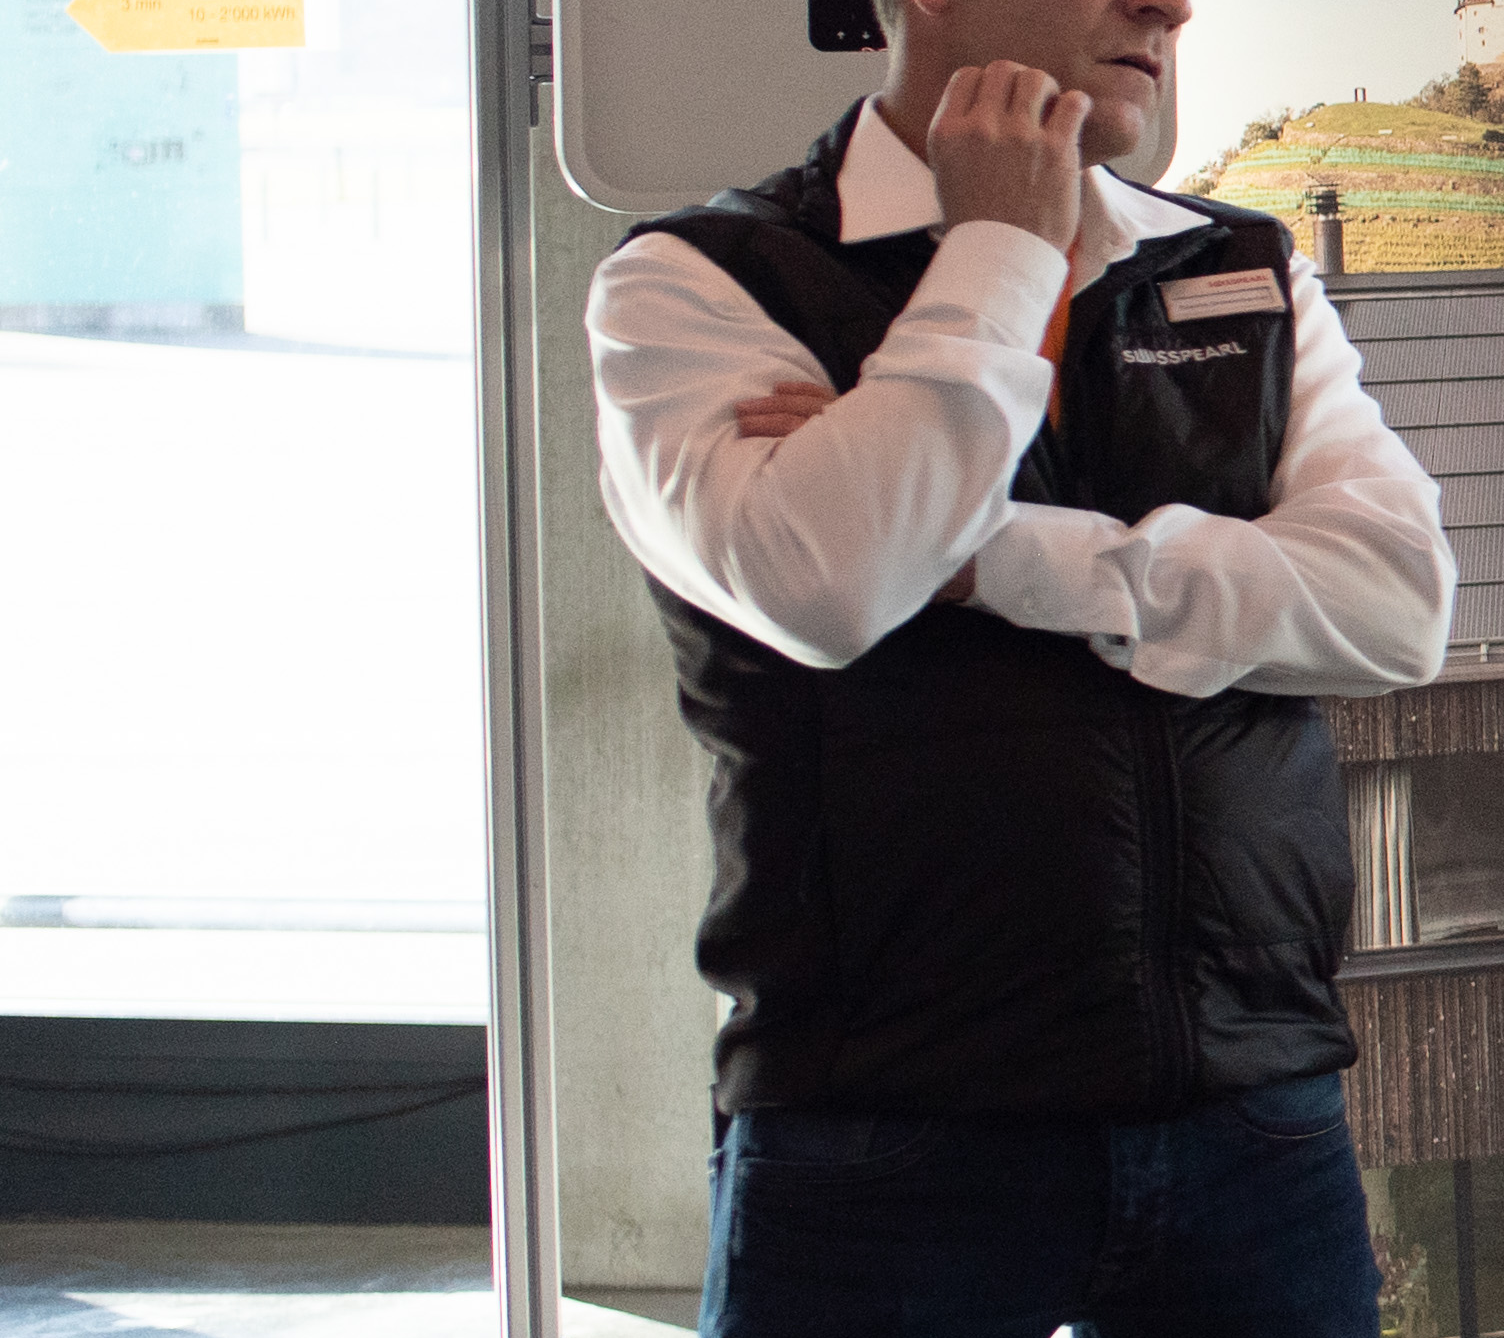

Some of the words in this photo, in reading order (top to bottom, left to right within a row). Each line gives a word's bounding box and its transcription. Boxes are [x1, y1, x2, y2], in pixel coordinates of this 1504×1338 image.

[188, 6, 206, 23] 10
[262, 4, 296, 22] kWh
[1122, 341, 1248, 365] SWISSPEARL
